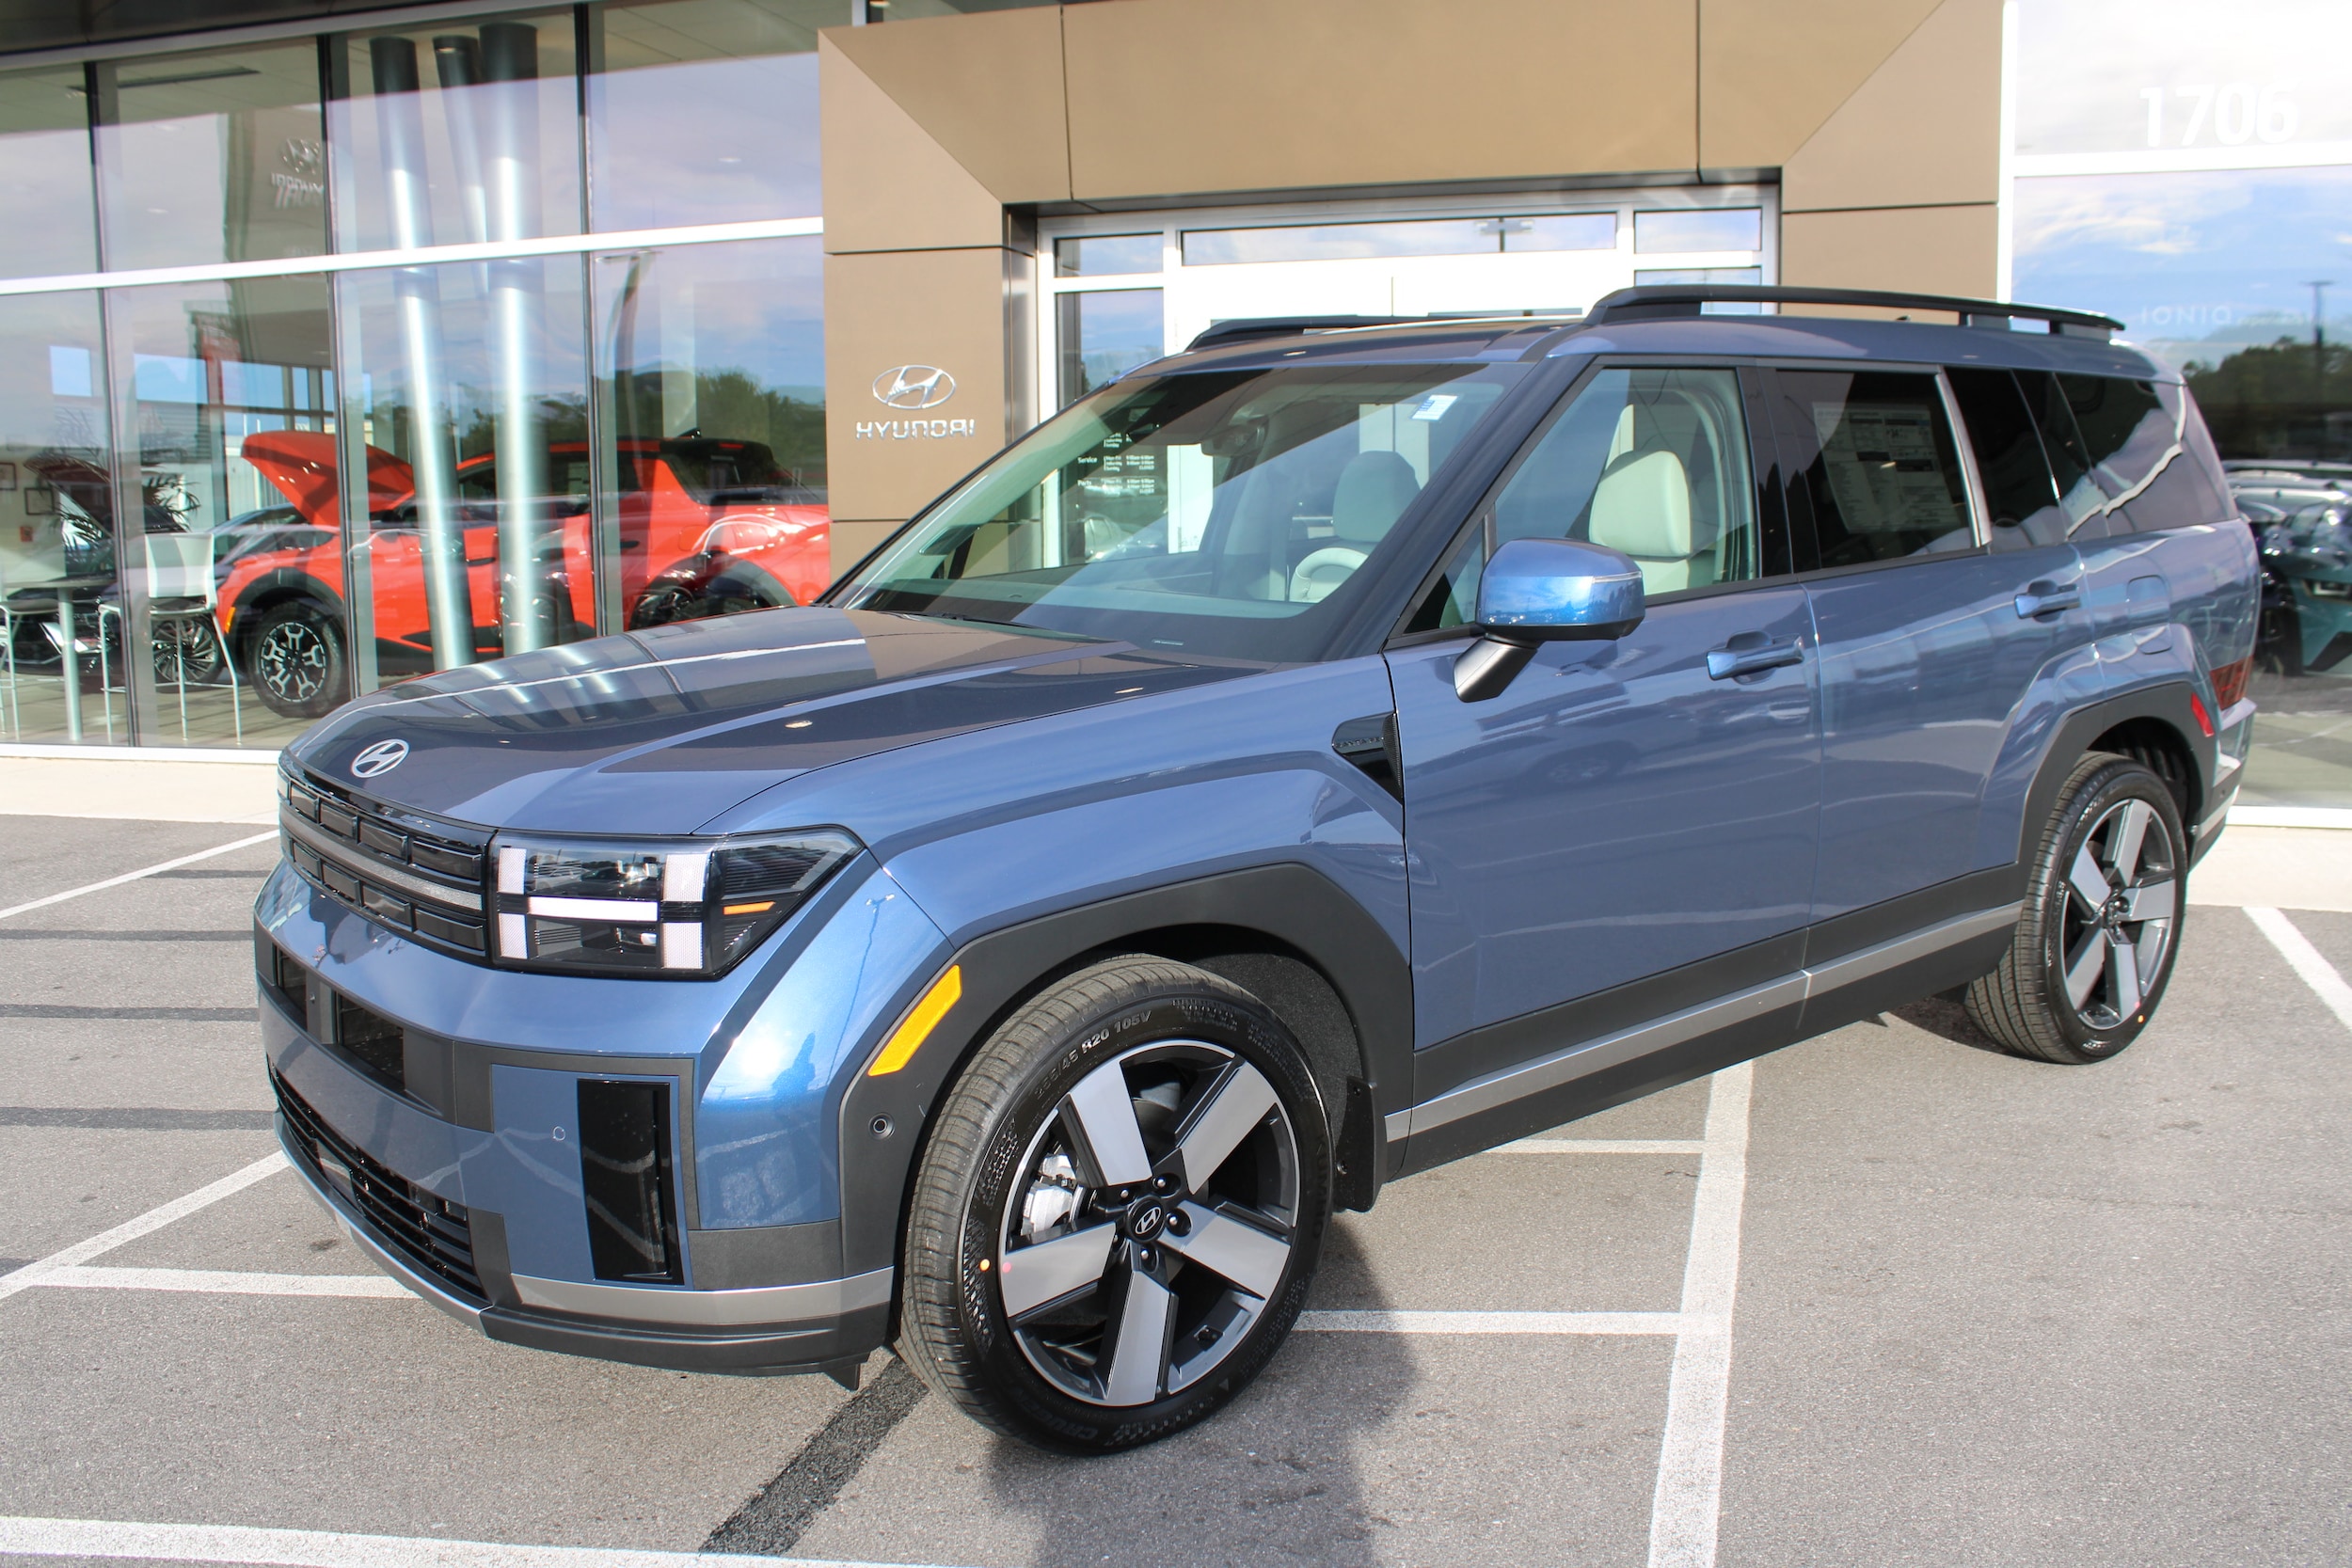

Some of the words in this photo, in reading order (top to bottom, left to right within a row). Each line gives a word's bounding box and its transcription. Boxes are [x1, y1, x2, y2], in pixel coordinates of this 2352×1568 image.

[2138, 76, 2302, 147] 1706
[2140, 305, 2232, 325] IONIQ
[856, 419, 975, 439] HYUNDAI
[1082, 1028, 1110, 1054] R20
[1114, 1010, 1152, 1033] 105V
